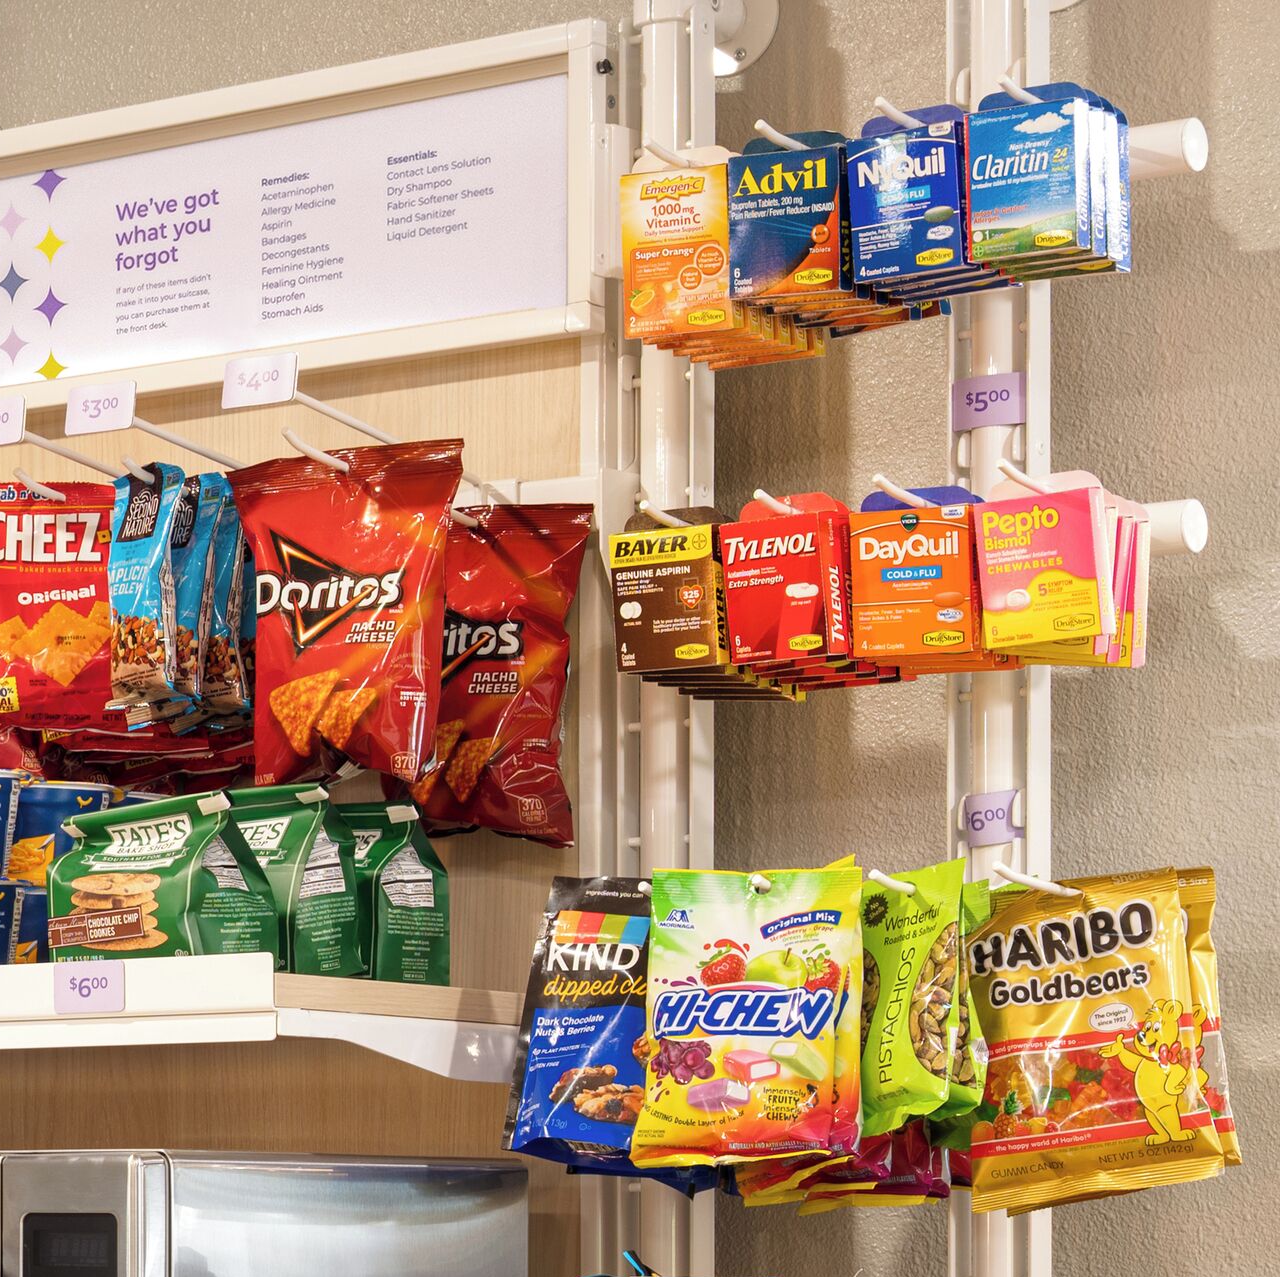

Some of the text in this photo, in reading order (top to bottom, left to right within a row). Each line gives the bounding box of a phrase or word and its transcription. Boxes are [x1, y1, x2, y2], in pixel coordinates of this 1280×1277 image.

[387, 150, 437, 165] Essentials:
[972, 149, 1048, 181] Claritin
[387, 156, 491, 181] Contact Lens Solution
[733, 158, 827, 197] Advil
[261, 172, 309, 187] Remedies:
[387, 178, 452, 196] Dry Shampoo
[645, 181, 702, 195] Emergen-C
[261, 182, 334, 202] Acetaminophen
[387, 187, 494, 211] Fabric Softener Sheets
[116, 189, 219, 221] We've got
[261, 197, 336, 217] Allergy Medicine
[261, 219, 292, 233] Aspirin
[387, 208, 456, 226] Hand Sanitizer
[116, 218, 210, 246] what you
[261, 232, 307, 246] Bandages
[387, 222, 468, 241] Liquid Detergent
[116, 246, 178, 271] forgot
[261, 243, 330, 262] Decongestants
[636, 247, 694, 260] Super Orange
[261, 256, 344, 276] Feminine Hygiene
[122, 286, 135, 294] any
[167, 278, 188, 286] items
[190, 274, 211, 283] didn't
[261, 271, 343, 290] Healing Ointment
[116, 299, 136, 308] make
[160, 294, 176, 303] your
[178, 288, 209, 298] suitcase,
[261, 291, 305, 305] Ibuprofen
[116, 315, 129, 323] you
[146, 307, 179, 318] purchase
[181, 303, 201, 312] them
[261, 303, 323, 321] Stomach Aids
[130, 324, 147, 333] front
[149, 321, 167, 329] desk.
[127, 497, 159, 520] SECOND
[122, 515, 155, 538] NATURE
[982, 505, 1059, 538] Pepto
[615, 536, 687, 557] BAYER
[725, 533, 815, 565] TYLENOL
[859, 531, 959, 564] DayQuil
[984, 534, 1031, 551] Bismol
[616, 565, 690, 580] GENUINE ASPIRIN
[887, 570, 912, 579] COLD
[920, 569, 936, 577] FLU
[255, 571, 400, 616] Doritos
[351, 620, 396, 633] NACHO
[345, 631, 395, 643] CHEESE
[112, 819, 187, 849] TATE'S
[88, 913, 139, 928] CHOCOLATE CHIP
[884, 903, 941, 932] Wonderful
[89, 928, 115, 938] COOKIES
[970, 901, 1156, 975] HARIBO
[546, 943, 639, 972] KIND
[990, 962, 1148, 1008] Goldbears
[653, 986, 835, 1040] HI-CHEW
[878, 947, 916, 1084] PISTACHIOS
